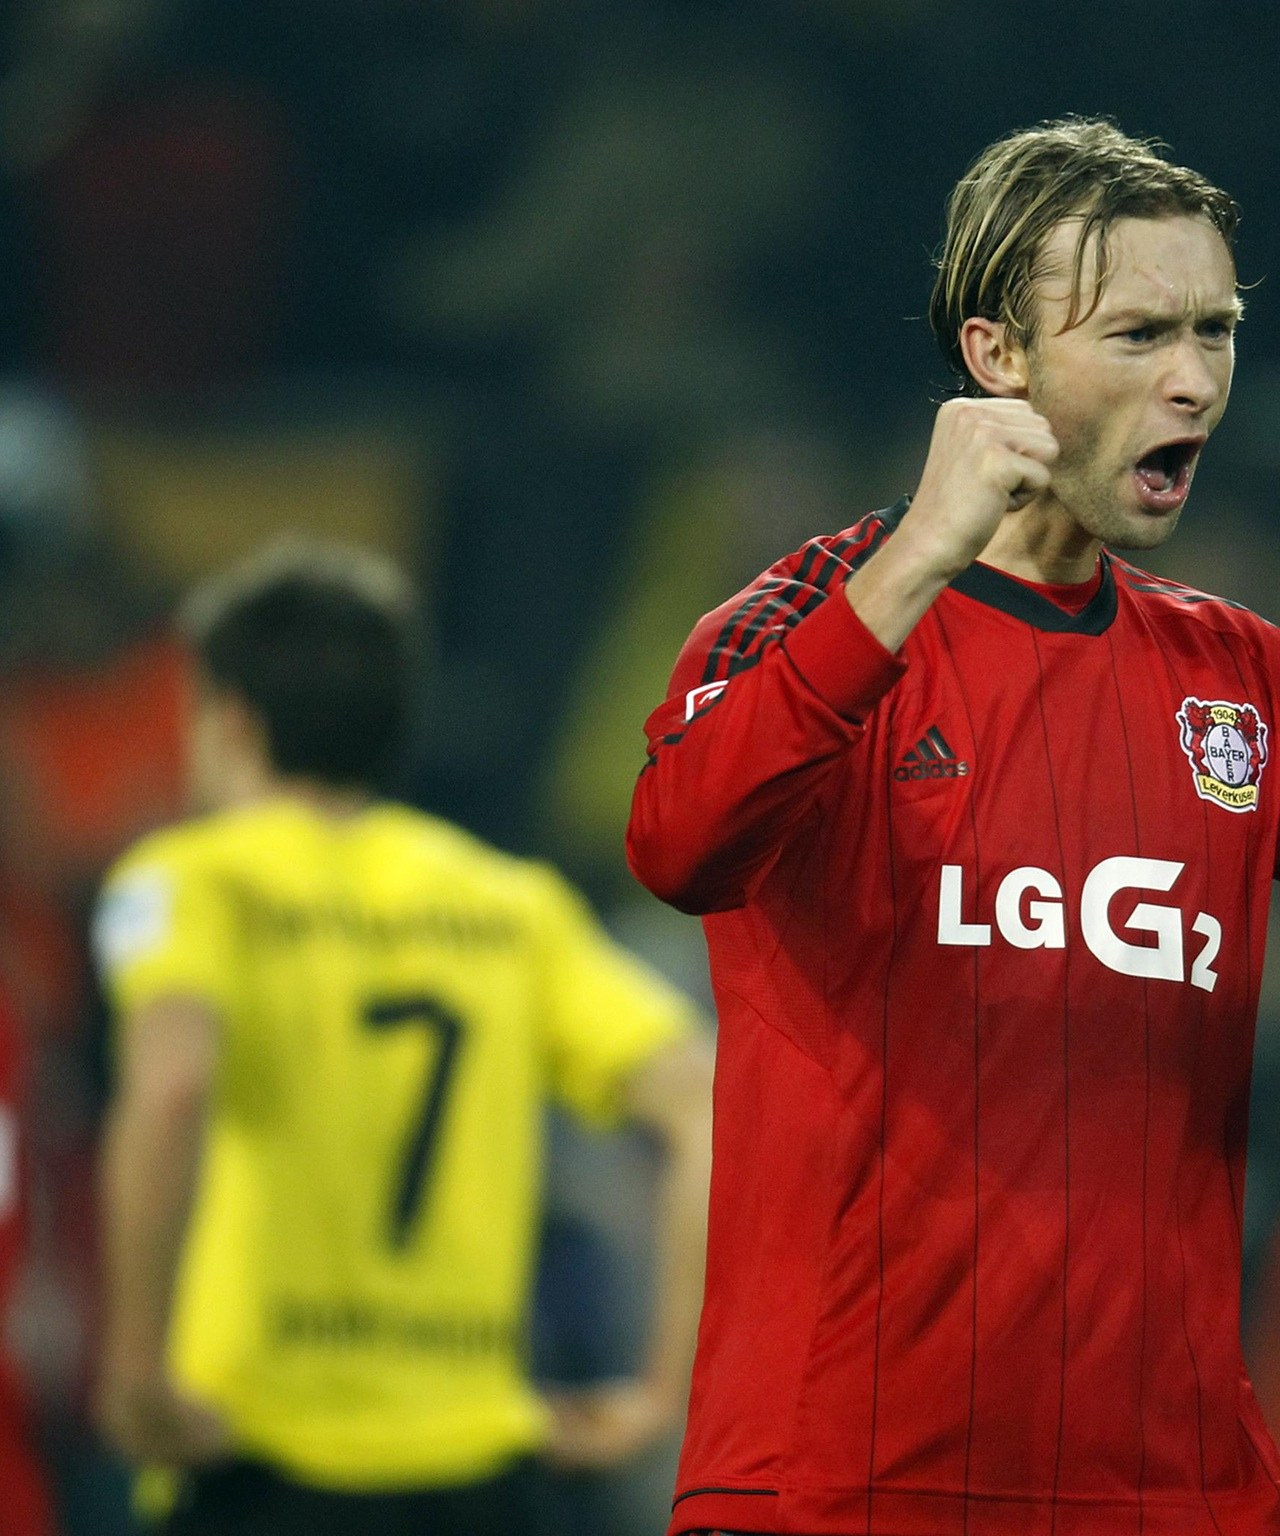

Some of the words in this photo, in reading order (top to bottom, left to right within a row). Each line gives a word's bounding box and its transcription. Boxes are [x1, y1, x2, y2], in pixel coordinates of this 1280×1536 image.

[1213, 709, 1239, 723] 1904
[1209, 746, 1245, 763] BAYER
[894, 761, 968, 782] adidas
[937, 864, 1066, 949] LG
[1080, 855, 1222, 993] G2
[362, 992, 465, 1258] 7
